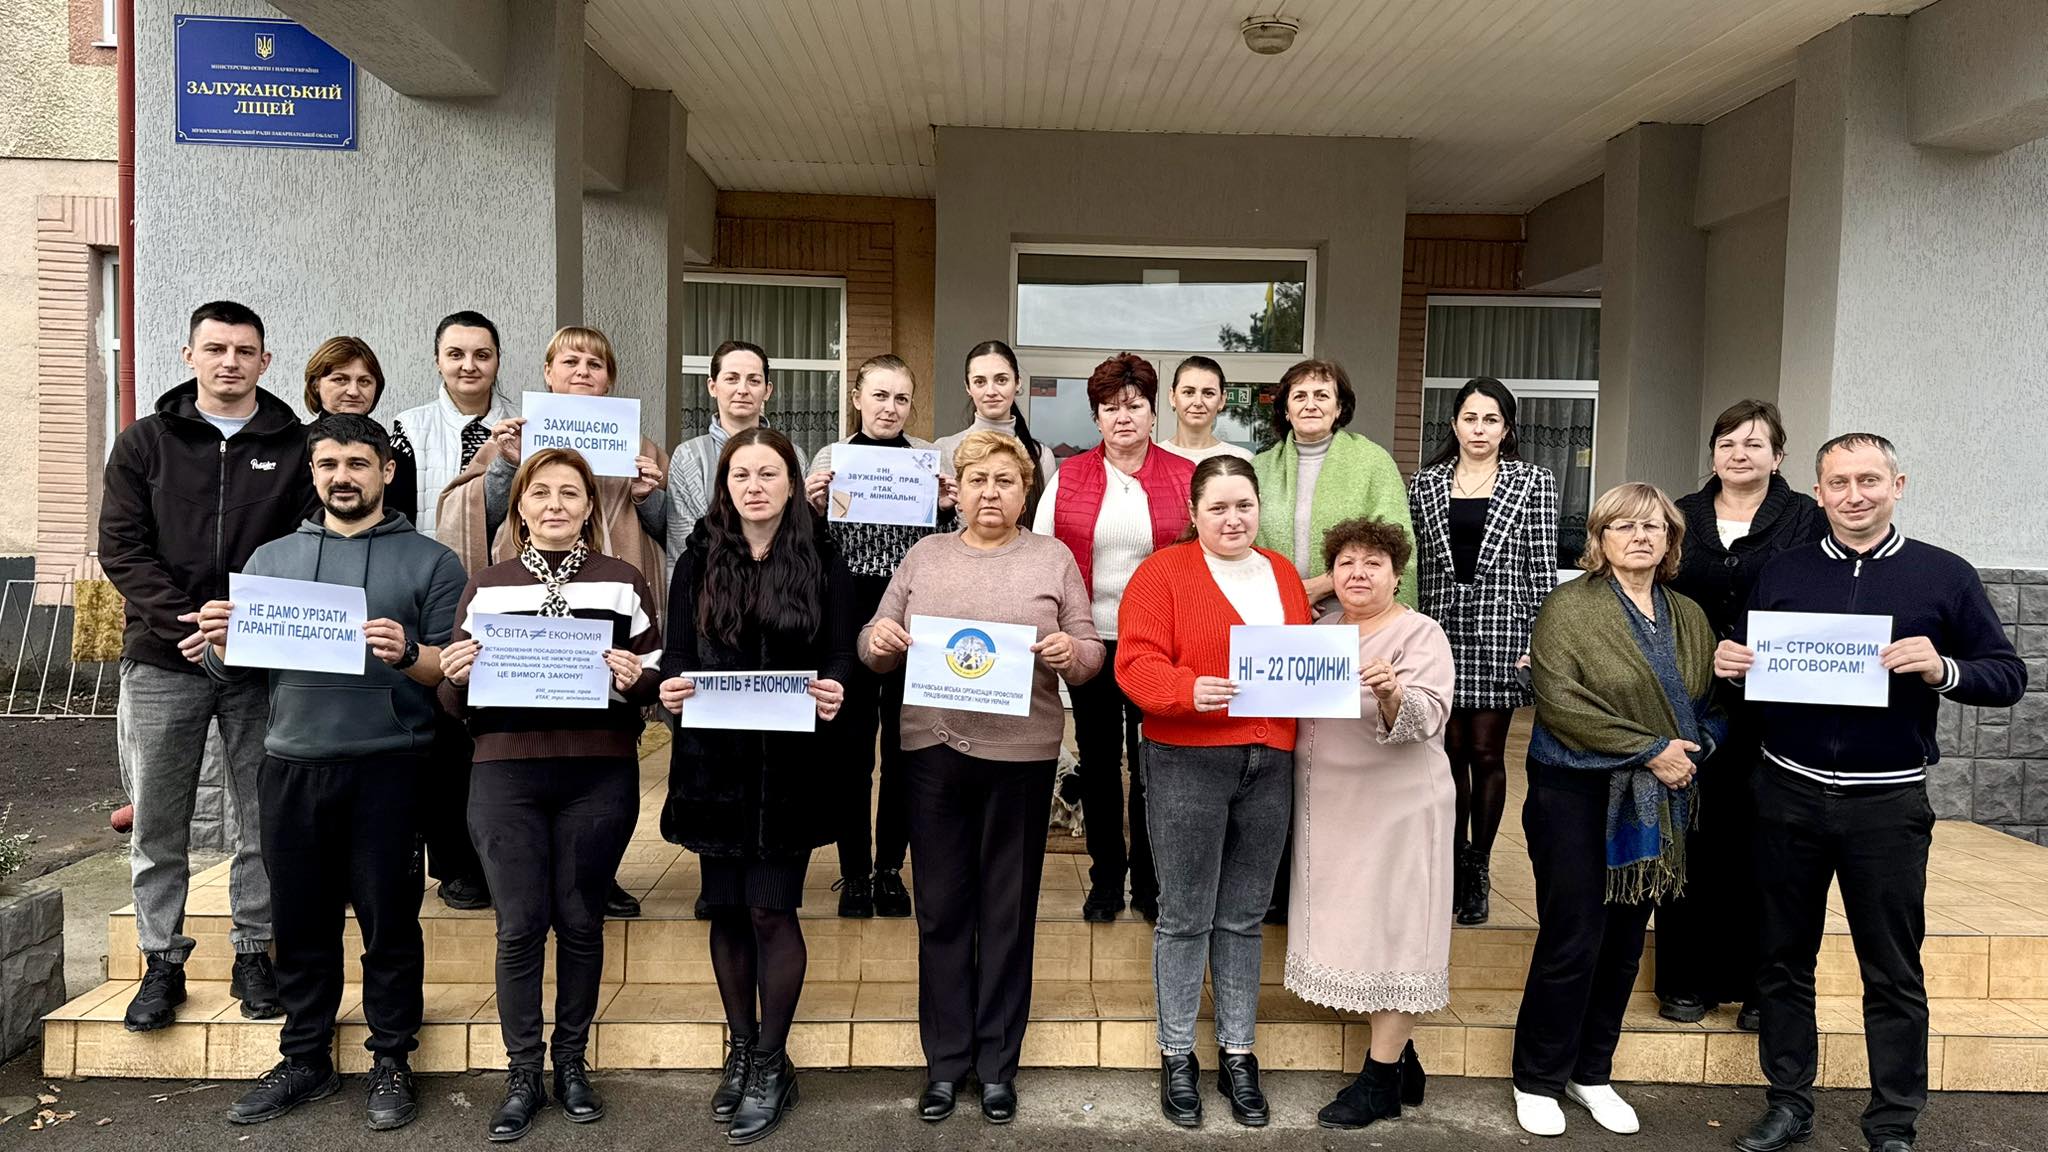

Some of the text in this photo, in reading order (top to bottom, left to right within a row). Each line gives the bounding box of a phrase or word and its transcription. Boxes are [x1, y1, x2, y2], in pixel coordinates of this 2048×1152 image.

[186, 80, 343, 100] ЗАЛУЖАНСЬКИЙ
[233, 100, 296, 117] ЛІЦЕЙ
[543, 418, 619, 434] ЗАХИЩАЄМО
[533, 434, 628, 451] ПРАВА ОСВІТЯН!
[249, 603, 347, 623] НЕ ДАМО УРІЗАТИ
[237, 620, 357, 642] ГАРАНТІЇ ПЕДАГОГАМ!
[548, 630, 602, 641] ЕКОНОМІЯ
[1756, 640, 1771, 653] НІ
[1786, 641, 1879, 656] СТРОКОВИМ
[1238, 656, 1253, 681] НІ
[1267, 656, 1284, 681] 22
[1287, 656, 1350, 686] ГОДИНИ!
[1767, 657, 1865, 674] ДОГОВОРАМ!
[497, 670, 583, 680] ЦЕ ВИМОГА ЗАКОНУ!
[753, 675, 810, 694] ЕКОНОМІЯ
